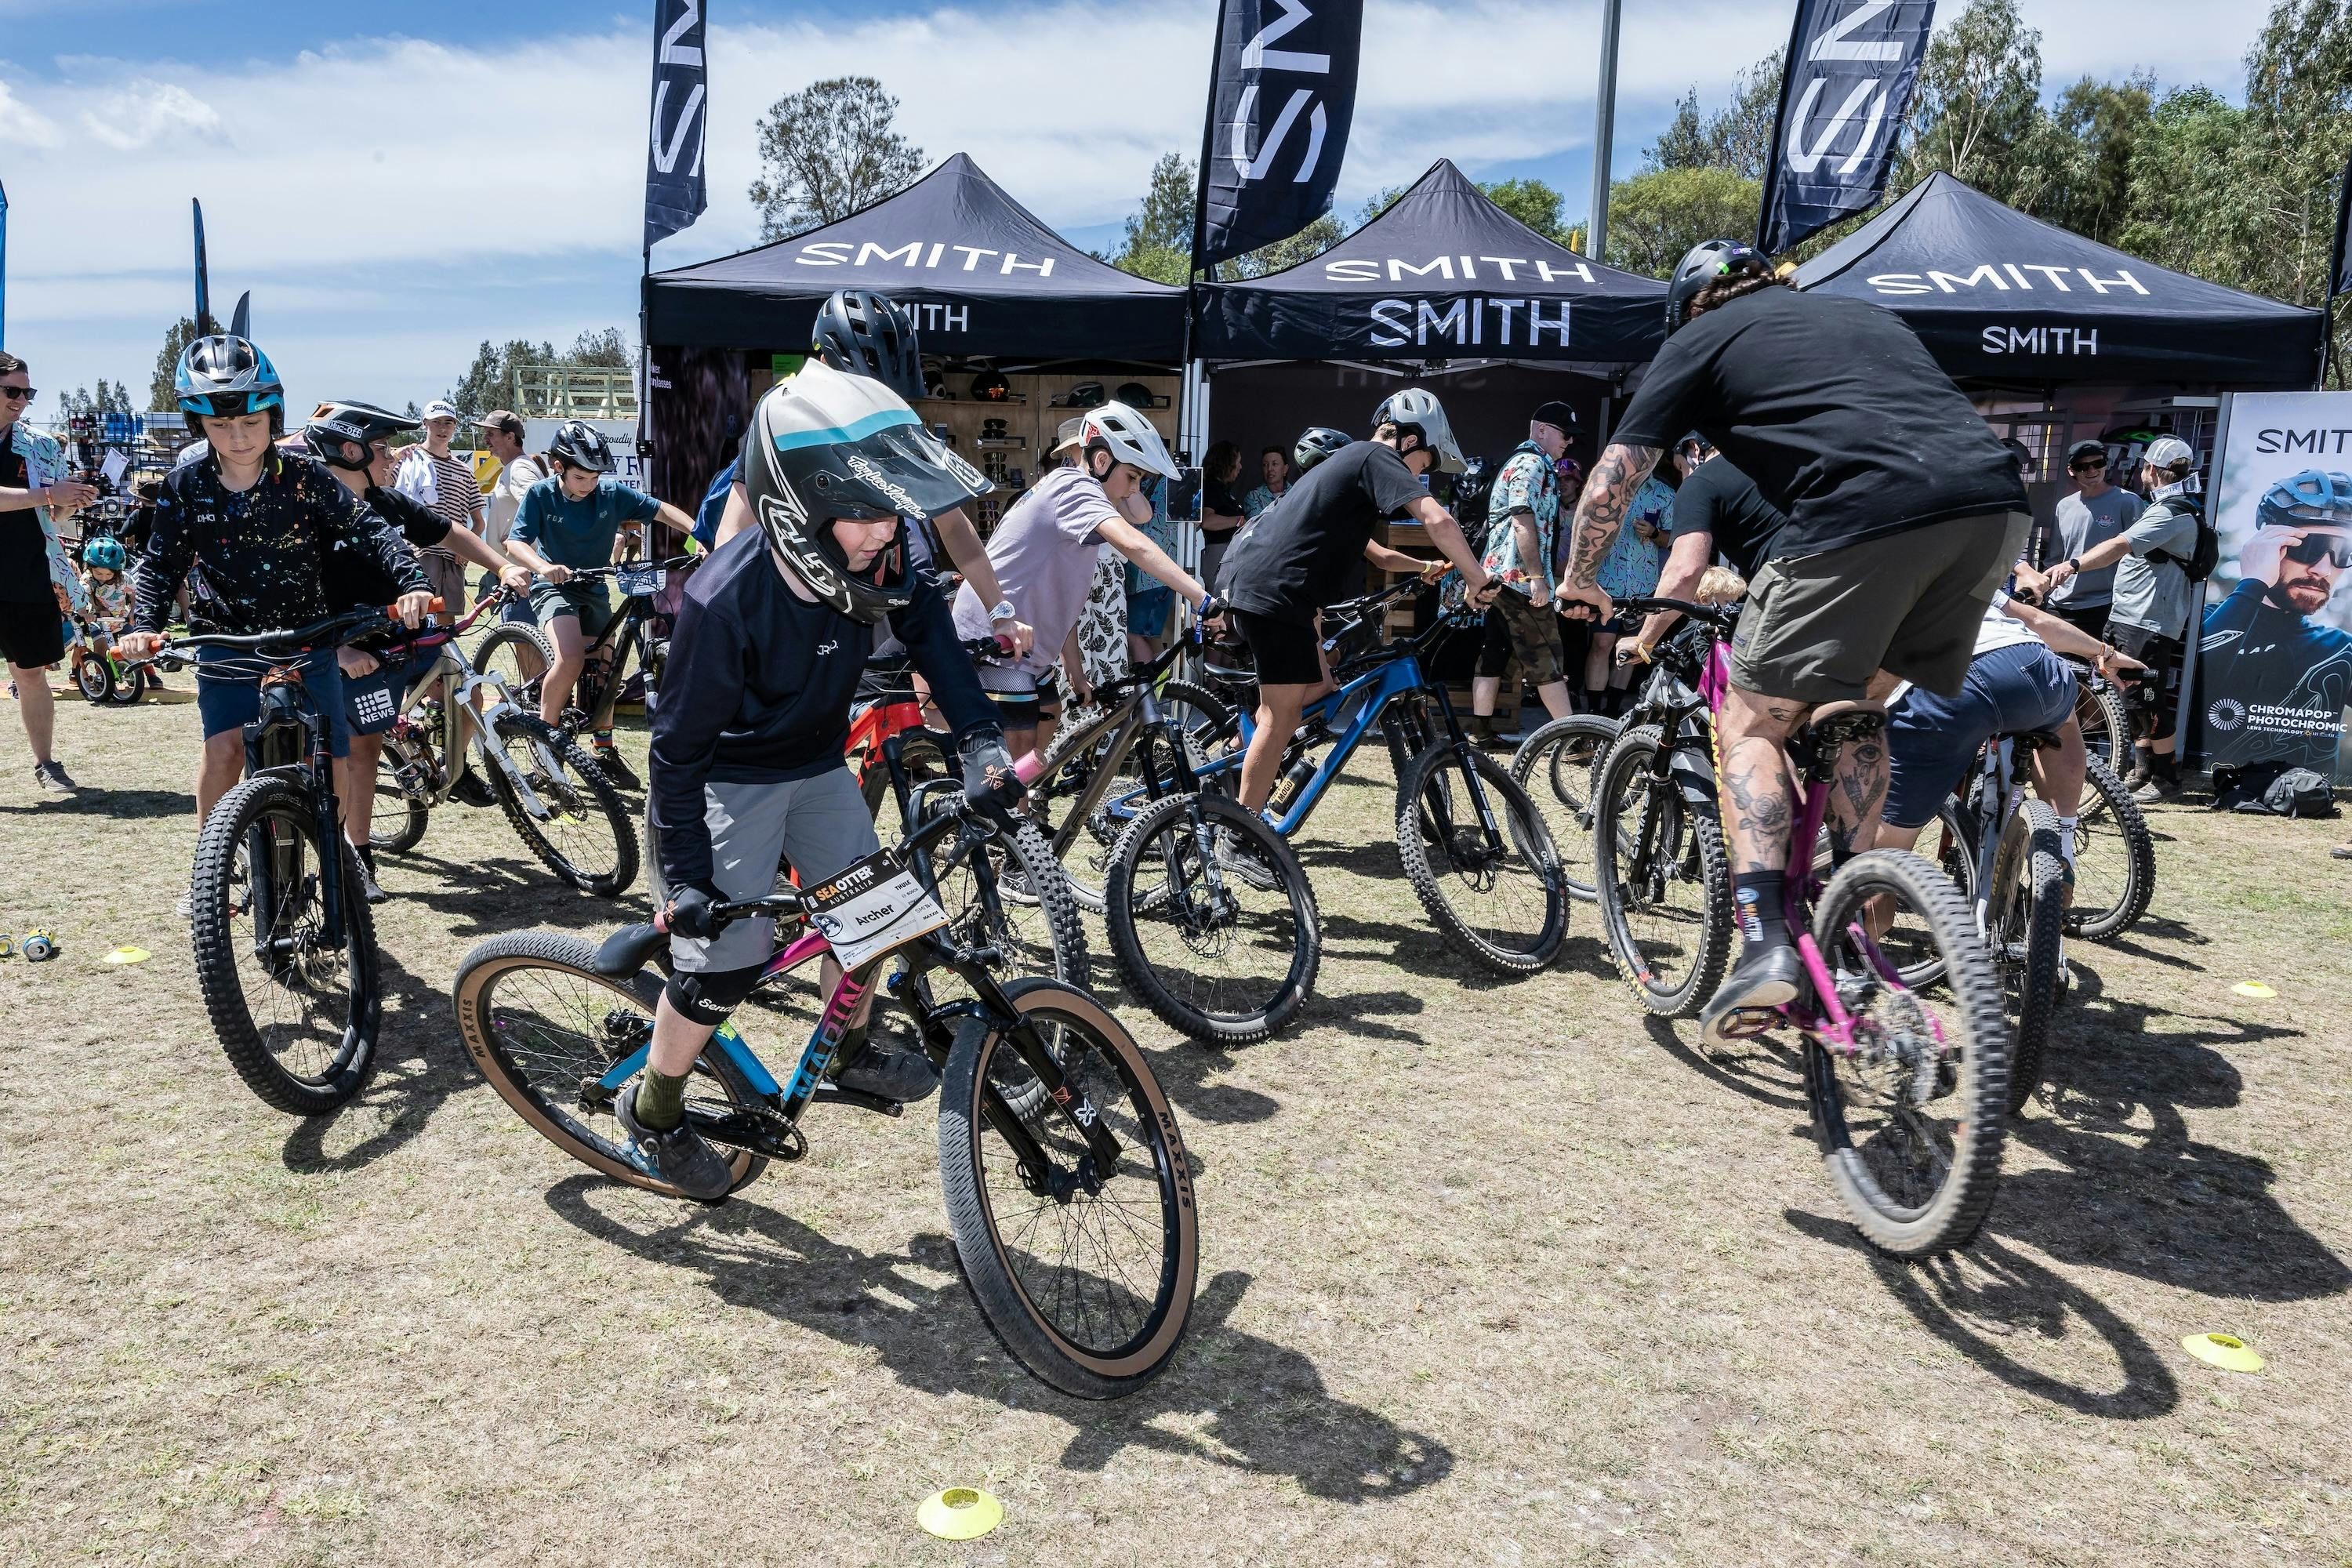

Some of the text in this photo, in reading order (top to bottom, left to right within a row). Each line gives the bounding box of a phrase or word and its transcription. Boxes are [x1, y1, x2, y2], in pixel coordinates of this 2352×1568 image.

[794, 241, 1056, 278] SMITH
[1326, 254, 1596, 283] SMITH
[1867, 263, 2151, 296] SMITH
[902, 303, 968, 332] MITH
[1370, 298, 1571, 347] SMITH
[1981, 325, 2098, 356] SMITH
[329, 421, 362, 437] Muc-Off
[2158, 485, 2178, 496] SMITH
[360, 707, 396, 724] NEWS
[2248, 714, 2348, 732] PHOTOCHROMIC
[2263, 726, 2304, 735] TECHNOLOGY
[1513, 751, 1530, 780] XXIS
[1277, 780, 1294, 803] MOGO
[829, 880, 874, 906] AUSTRALIA
[895, 879, 912, 891] THULE
[855, 903, 895, 926] Archer
[915, 902, 933, 913] SMITH
[923, 910, 939, 920] MAXXIS
[1619, 959, 1650, 998] MAXXIS
[463, 999, 486, 1058] MAXXIS
[793, 979, 866, 1098] MARIN
[1158, 1112, 1192, 1208] MAXXIS
